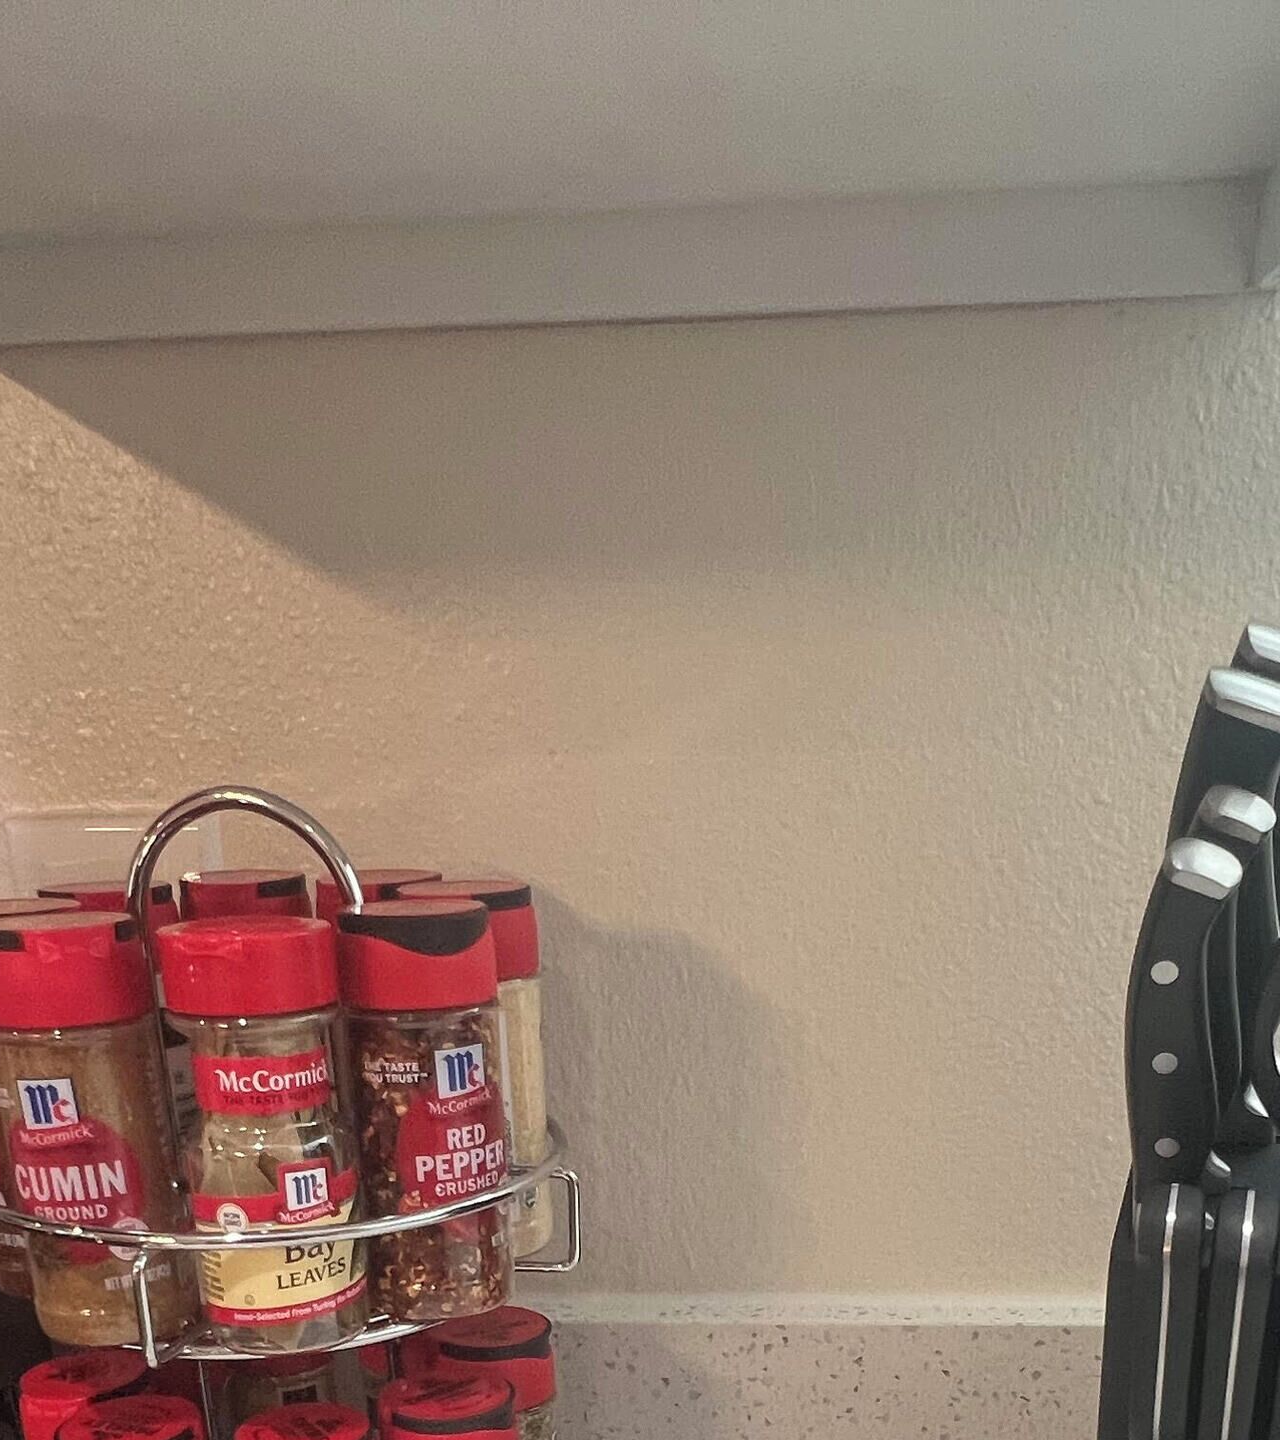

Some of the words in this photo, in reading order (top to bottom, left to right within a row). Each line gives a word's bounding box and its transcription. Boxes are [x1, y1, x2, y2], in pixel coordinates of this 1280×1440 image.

[383, 1062, 419, 1072] TASTE
[385, 1073, 420, 1084] TRUST
[427, 1088, 493, 1116] McCormick
[19, 1124, 95, 1146] McCormick
[446, 1123, 486, 1150] RED
[415, 1139, 505, 1182] PEPPER
[15, 1160, 128, 1201] CUMIN
[434, 1170, 500, 1198] CRUSHED
[34, 1204, 109, 1221] GROUND
[278, 1200, 336, 1223] McCormick
[284, 1241, 336, 1264] Bay
[276, 1256, 346, 1290] LEAVES
